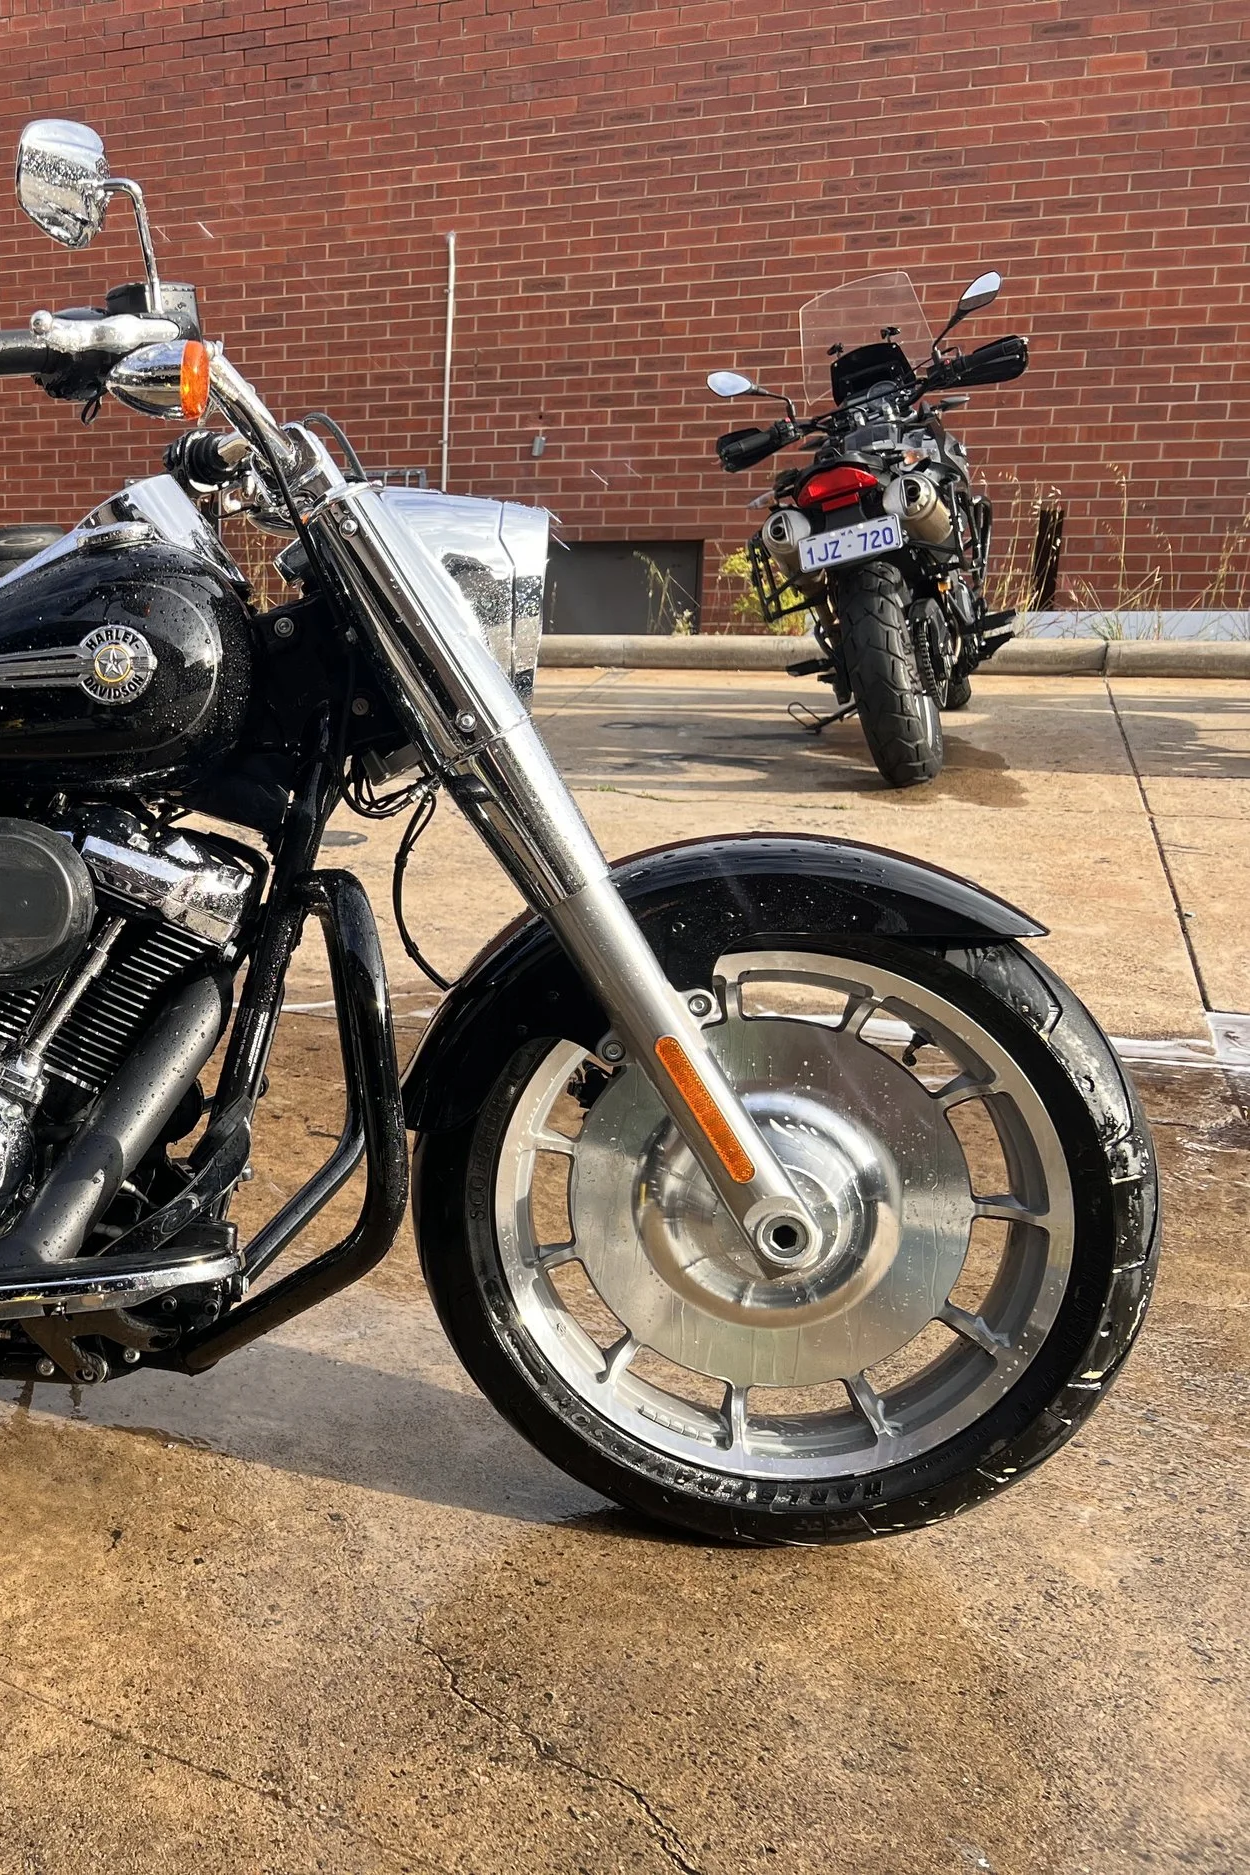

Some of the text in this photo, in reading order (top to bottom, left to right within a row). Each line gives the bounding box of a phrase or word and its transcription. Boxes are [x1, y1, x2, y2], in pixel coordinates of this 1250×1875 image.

[807, 527, 894, 565] 1JZ 720
[85, 629, 140, 651] HARLEY-
[83, 674, 145, 700] DAVIDSON
